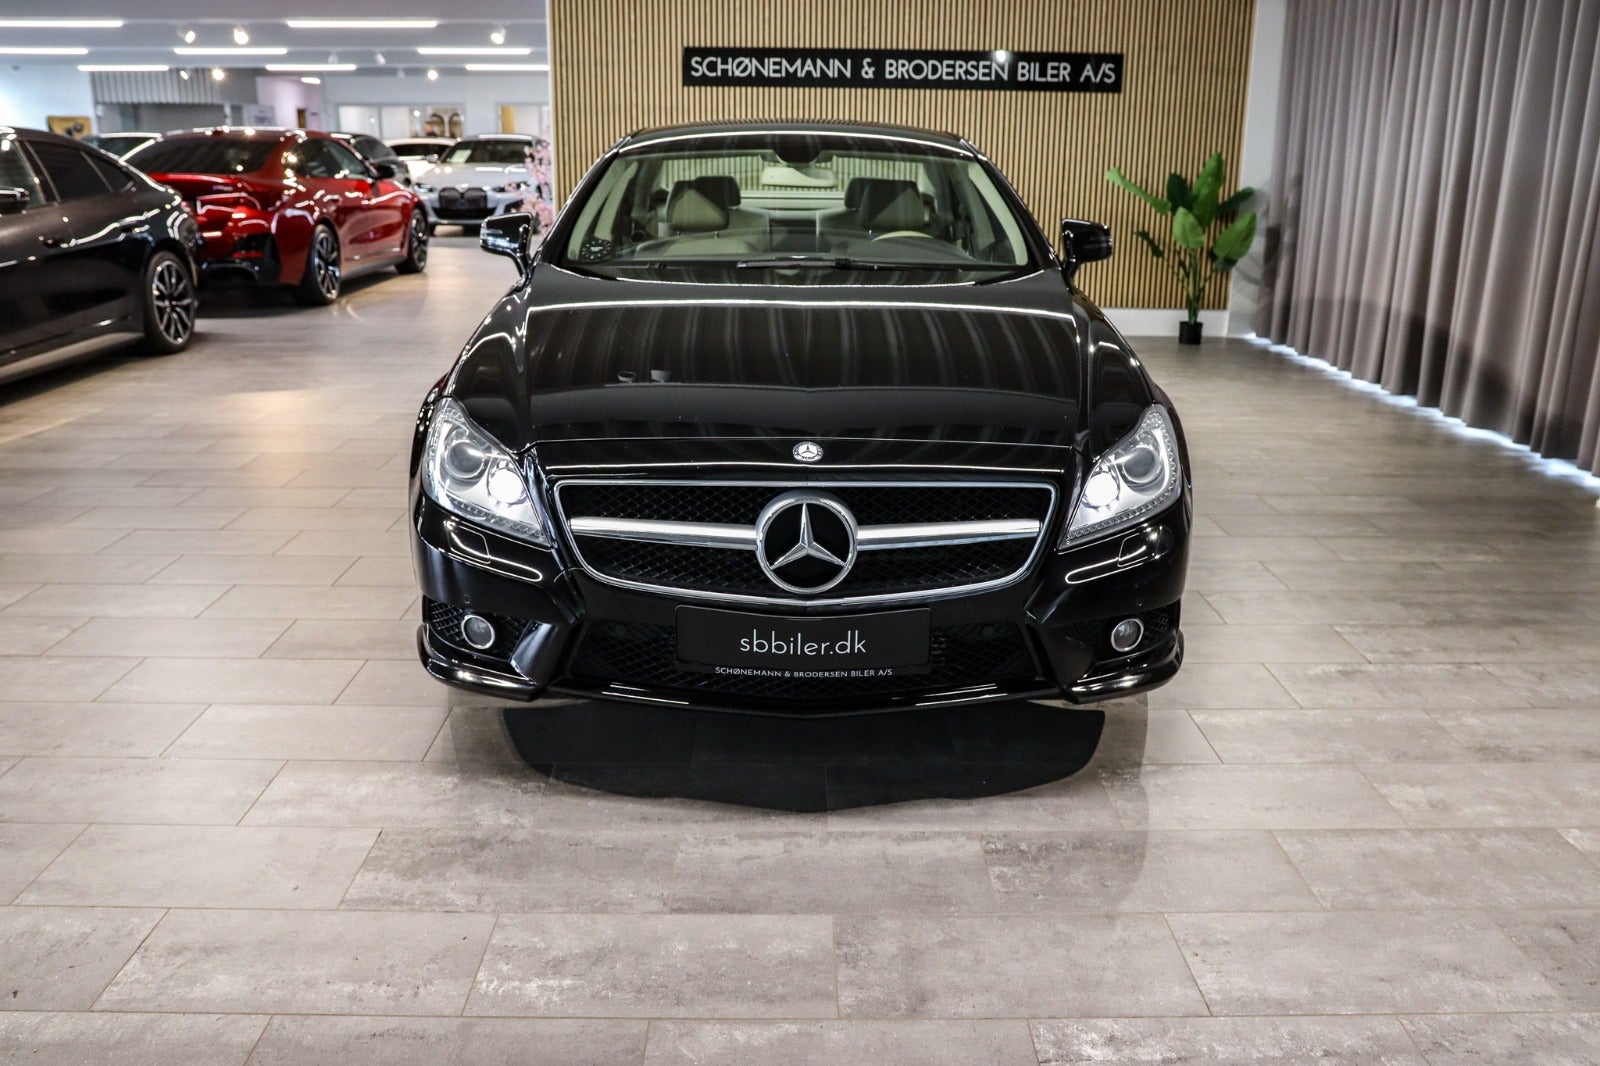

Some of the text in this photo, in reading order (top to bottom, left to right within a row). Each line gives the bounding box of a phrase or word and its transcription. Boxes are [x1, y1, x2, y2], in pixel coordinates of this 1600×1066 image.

[690, 56, 1116, 83] SCHØNEMANN & BRODERSEN BILER A/S
[739, 628, 867, 656] sbbiler.dk
[715, 666, 893, 678] SCHØNEMANN & BRODERSEN BILER A/S
